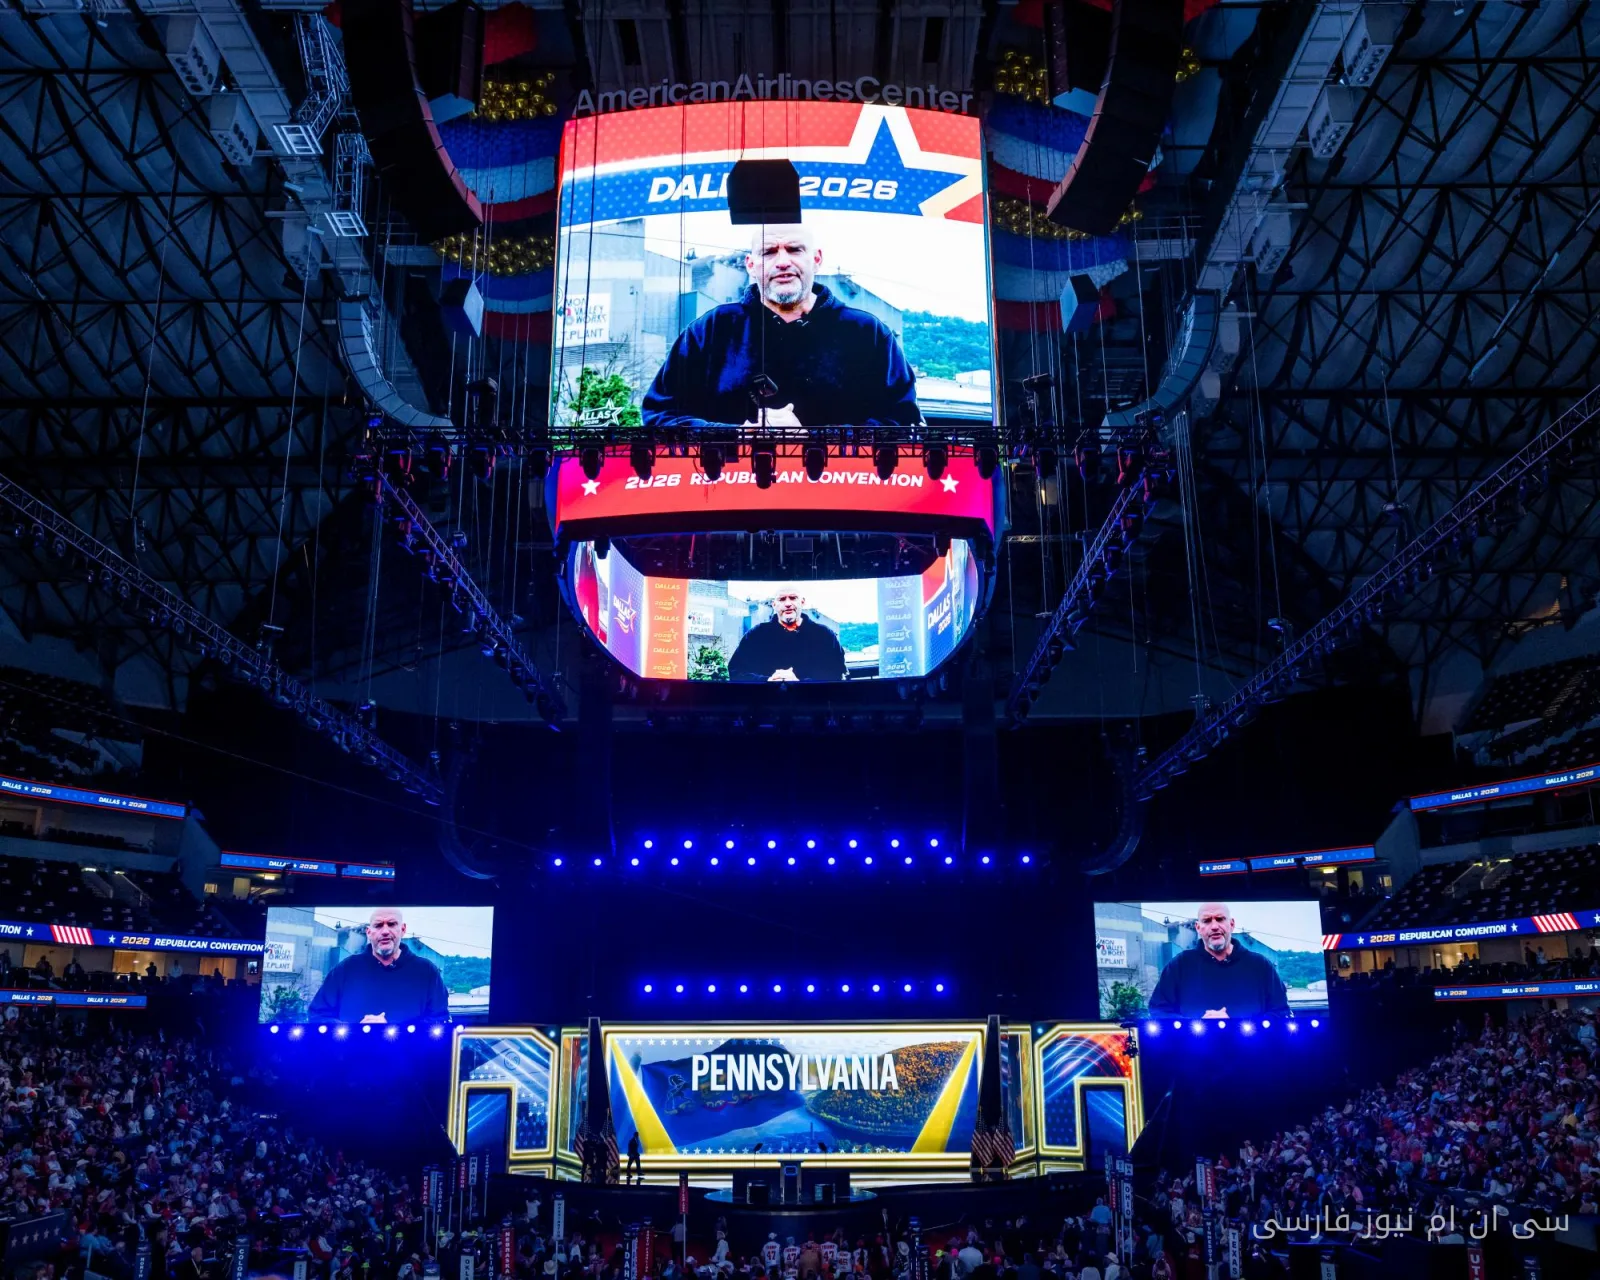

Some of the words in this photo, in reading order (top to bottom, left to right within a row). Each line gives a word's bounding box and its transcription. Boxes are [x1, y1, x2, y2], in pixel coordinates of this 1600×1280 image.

[573, 73, 974, 119] AmericanAirlinesCenter
[648, 172, 730, 203] DALL
[799, 176, 899, 200] 2026
[624, 473, 681, 489] 2026
[689, 471, 804, 485] REPUBLAN
[927, 592, 951, 630] DALLAS
[886, 645, 913, 653] DALLAS
[1, 781, 22, 790] DALLAS
[1545, 776, 1568, 785] DALLAS
[98, 796, 120, 805] DALLAS
[1451, 792, 1472, 800] DALLAS
[361, 868, 383, 876] DALLAS
[1370, 934, 1395, 943] 2026
[1399, 929, 1452, 941] REPUBLICAN
[1455, 924, 1506, 937] CONVENTION
[121, 936, 151, 945] 2026
[154, 938, 208, 949] REPUBLICAN
[210, 941, 264, 952] CONVENTION
[692, 1053, 899, 1091] PENNSYLVANIA
[766, 1251, 776, 1260] 47
[786, 1253, 796, 1261] 47
[236, 1249, 245, 1280] COLOR
